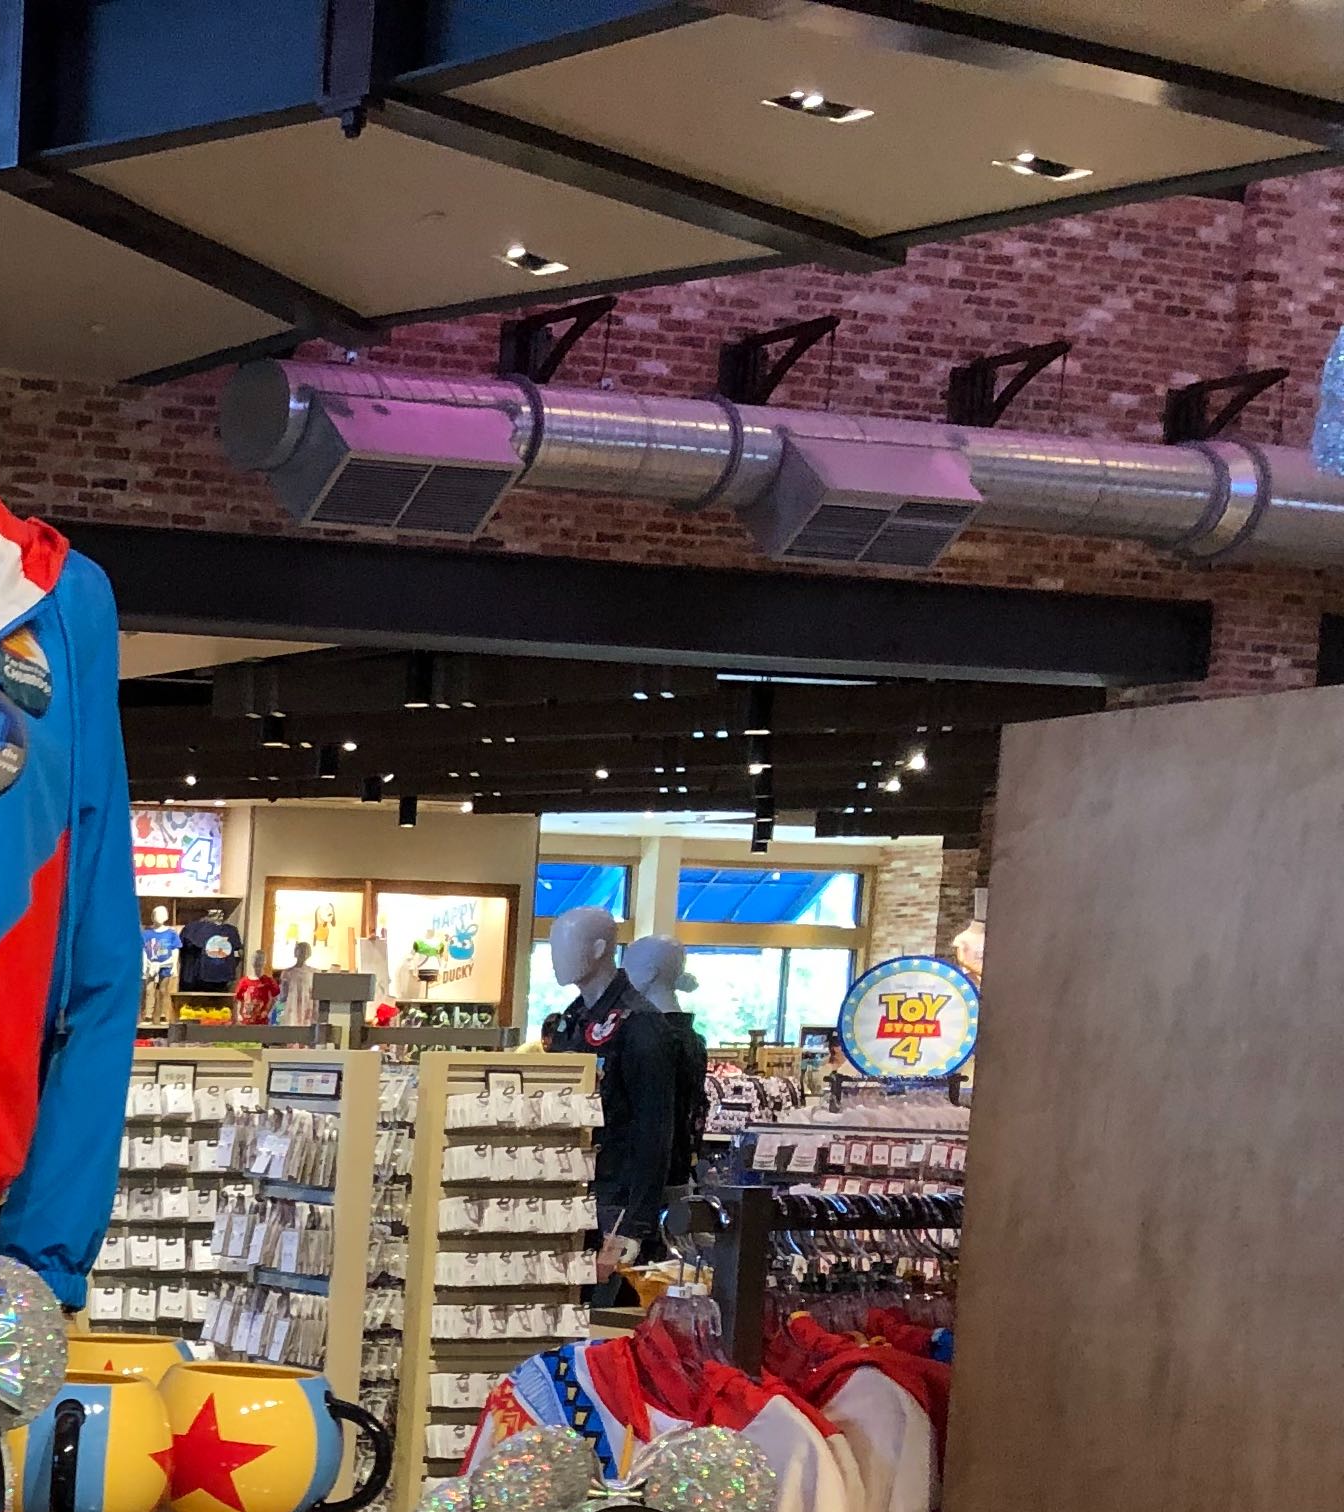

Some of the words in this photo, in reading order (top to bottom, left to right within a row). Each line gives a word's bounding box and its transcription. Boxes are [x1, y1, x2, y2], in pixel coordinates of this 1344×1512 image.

[180, 836, 215, 883] 4
[431, 900, 478, 930] HAPPY
[442, 962, 475, 985] DUCKY
[879, 992, 951, 1022] TOY
[883, 1022, 937, 1034] STORY
[889, 1036, 923, 1066] 4
